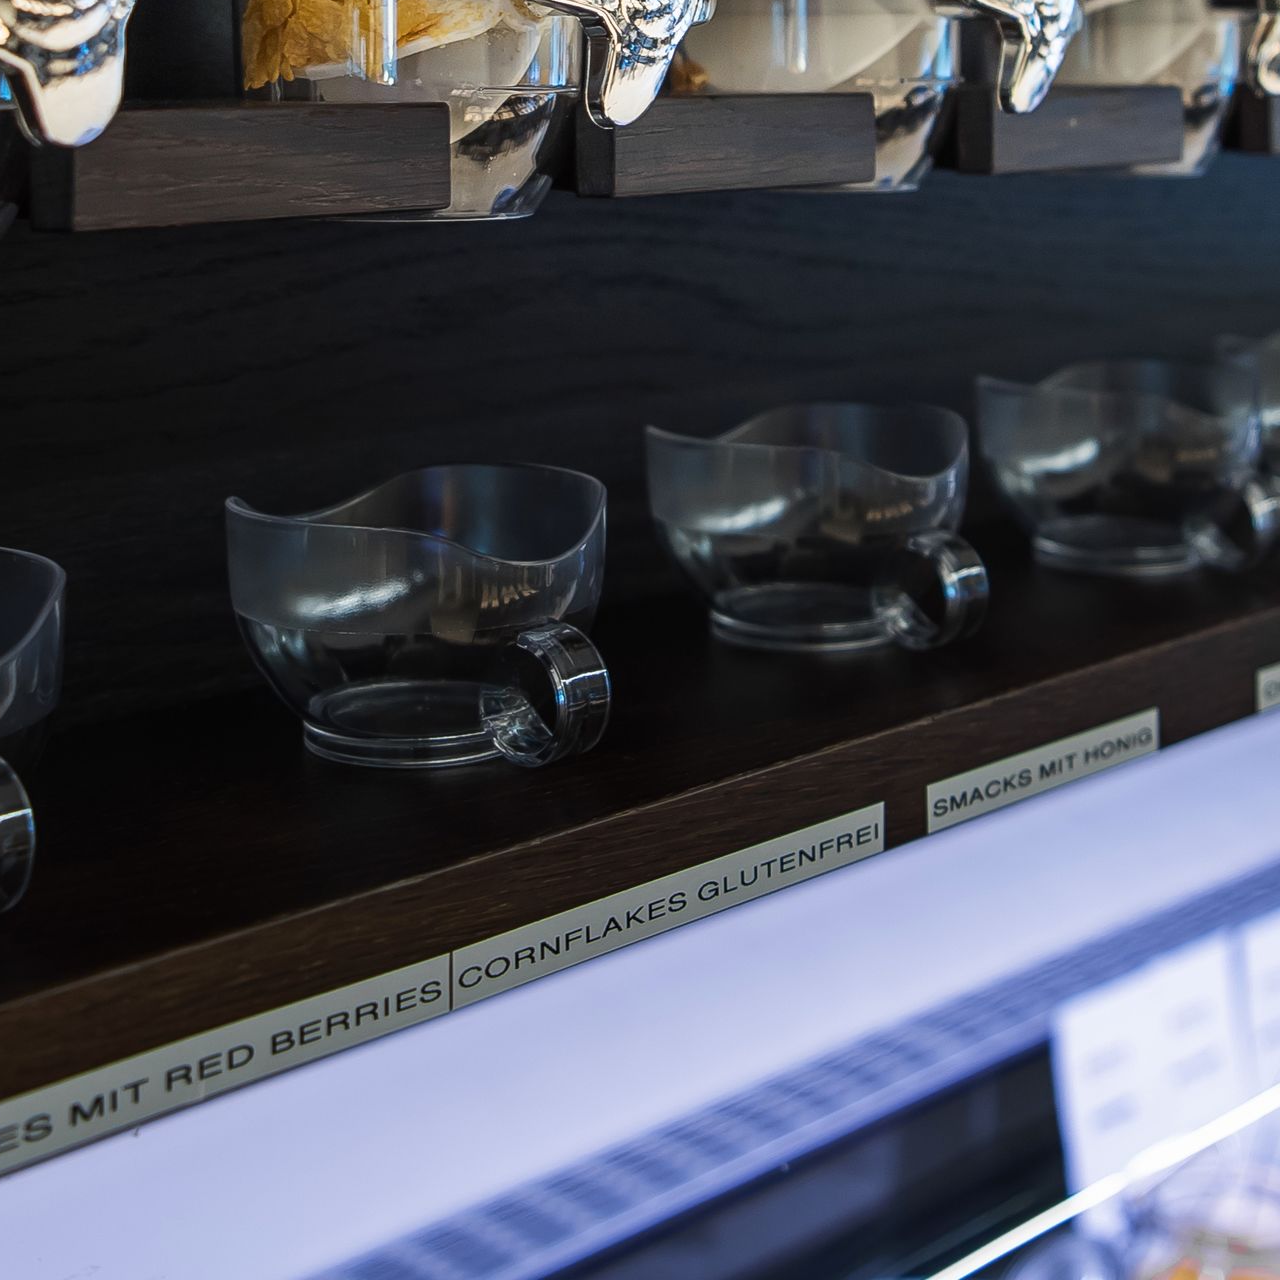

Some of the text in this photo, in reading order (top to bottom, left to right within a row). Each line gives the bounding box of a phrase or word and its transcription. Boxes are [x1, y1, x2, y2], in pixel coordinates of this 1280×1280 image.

[933, 726, 1153, 817] SMACKS MIT HONIG
[458, 823, 880, 989] CORNFLAKES GLUTENFREI
[70, 1078, 149, 1127] MIT
[165, 1044, 254, 1092] RED
[271, 980, 442, 1055] BERRIES
